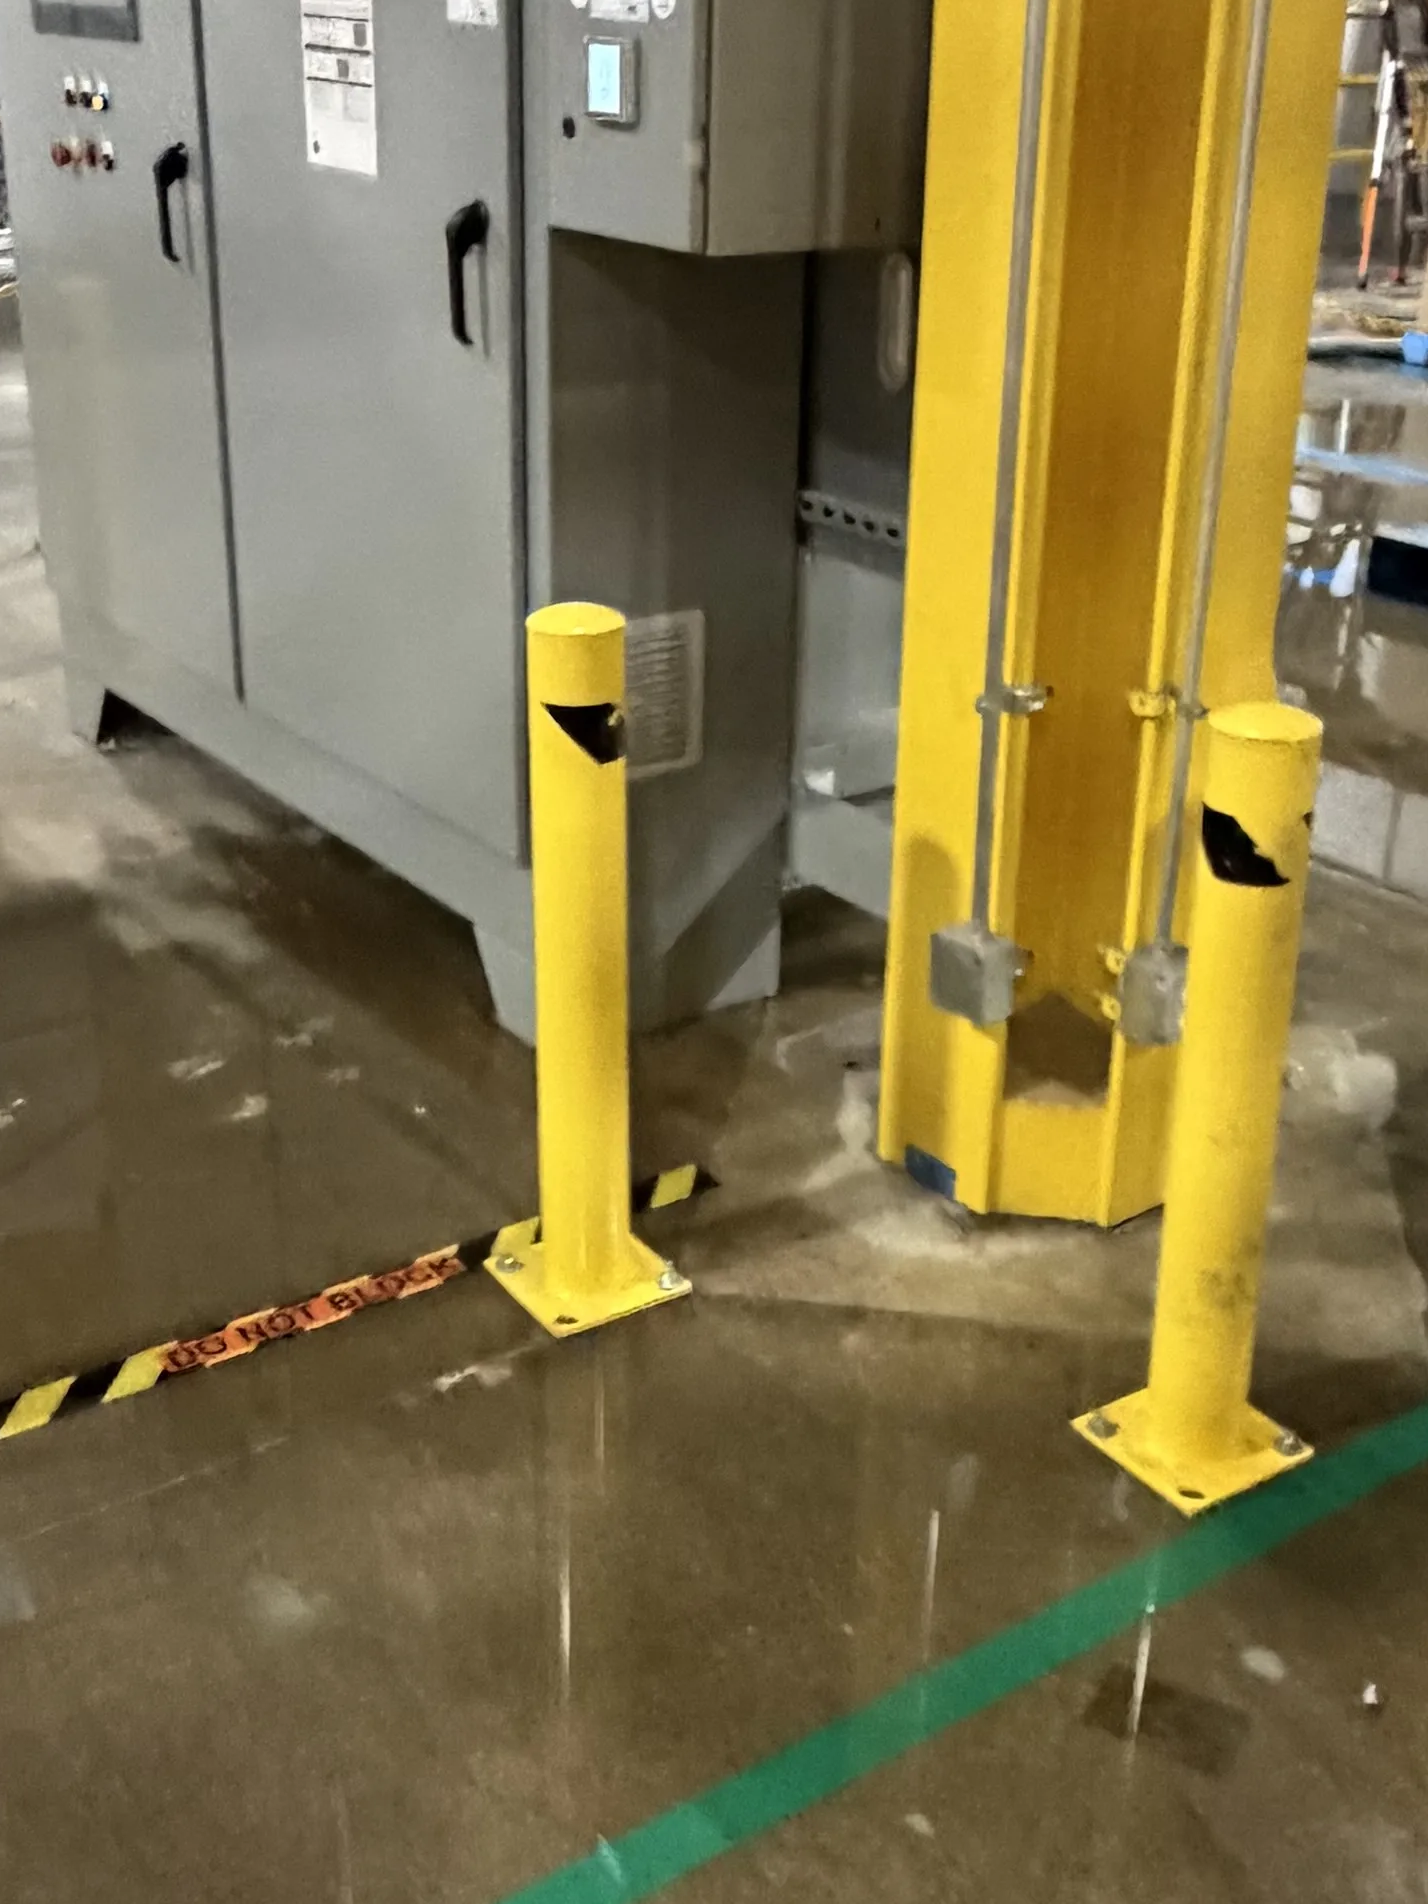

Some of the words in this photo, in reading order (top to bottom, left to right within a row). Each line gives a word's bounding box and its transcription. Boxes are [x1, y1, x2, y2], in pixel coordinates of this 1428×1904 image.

[167, 1335, 228, 1370] DO
[236, 1304, 315, 1344] NOT
[329, 1257, 451, 1311] BLOCK
